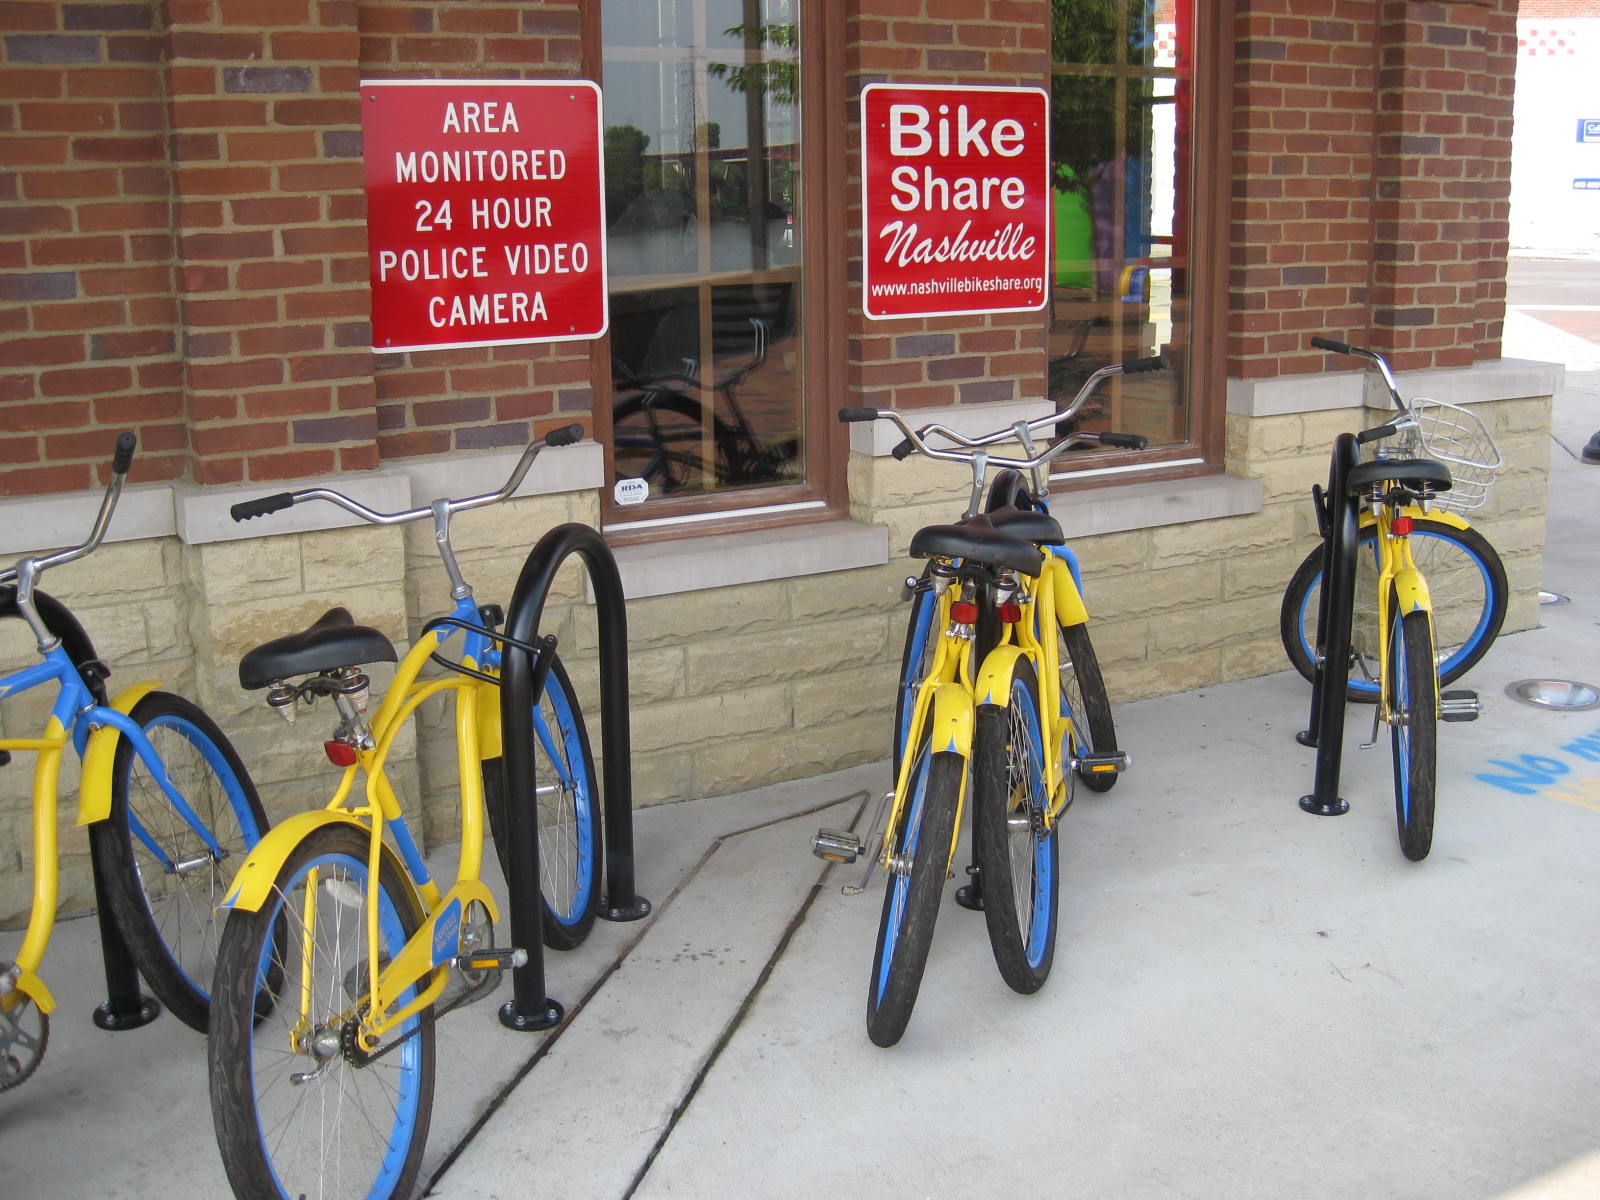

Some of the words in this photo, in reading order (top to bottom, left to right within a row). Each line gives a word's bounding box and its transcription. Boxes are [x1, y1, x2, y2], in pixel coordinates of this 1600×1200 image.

[442, 101, 520, 134] AREA
[889, 104, 1025, 157] Bike
[395, 149, 567, 184] MONITORED
[890, 165, 1025, 212] Share
[415, 199, 453, 232] 24
[471, 196, 552, 230] HOUR
[379, 246, 489, 282] POLICE
[504, 242, 589, 276] VIDEO
[879, 219, 1036, 268] Nashville
[871, 275, 1043, 297] www.nashvillebikeshare.org
[428, 291, 549, 328] CAMERA
